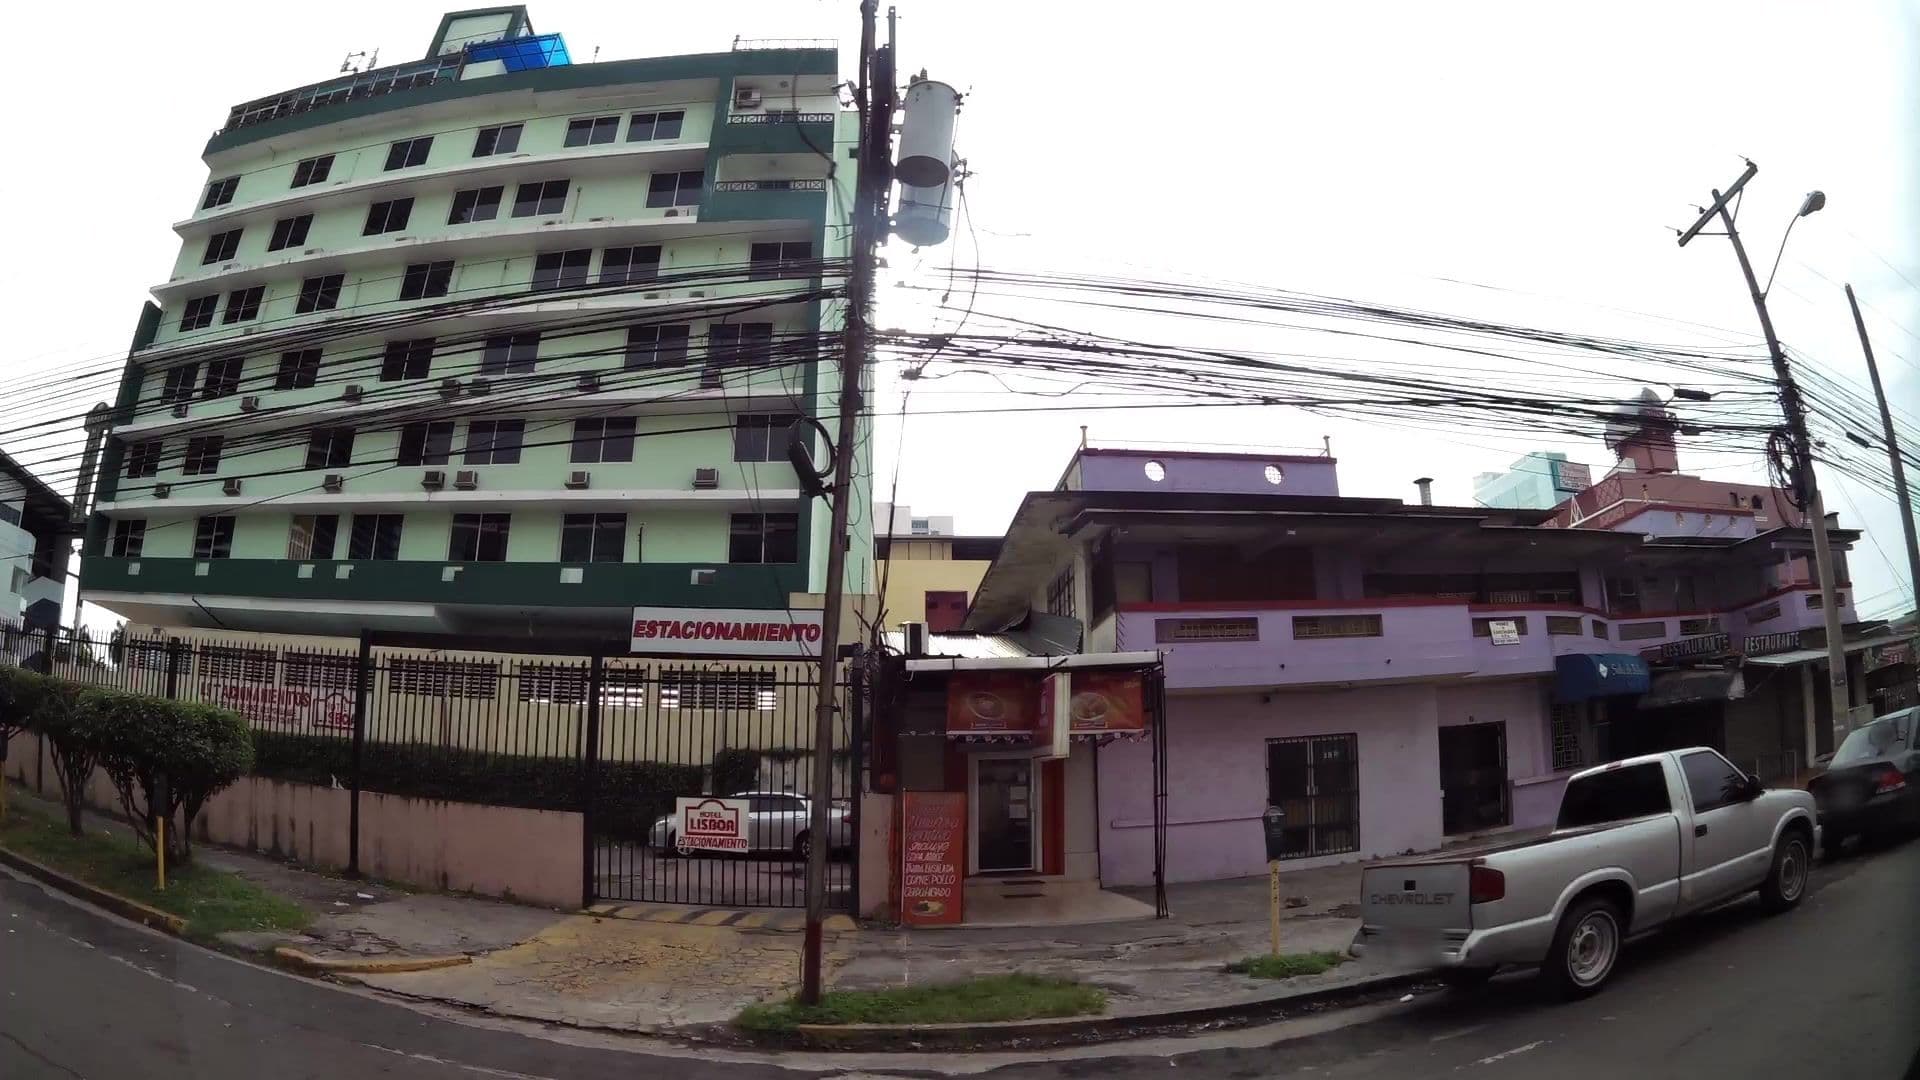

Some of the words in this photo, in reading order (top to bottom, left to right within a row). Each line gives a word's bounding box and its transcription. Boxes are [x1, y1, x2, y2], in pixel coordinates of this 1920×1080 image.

[633, 620, 821, 642] ESTACIONAMIENTO
[1744, 631, 1800, 653] RESTAURANTE
[1663, 634, 1729, 657] RESTAURANTE
[678, 836, 748, 849] ESTACIONAMIENTO
[1371, 893, 1455, 904] CHEVROLET
